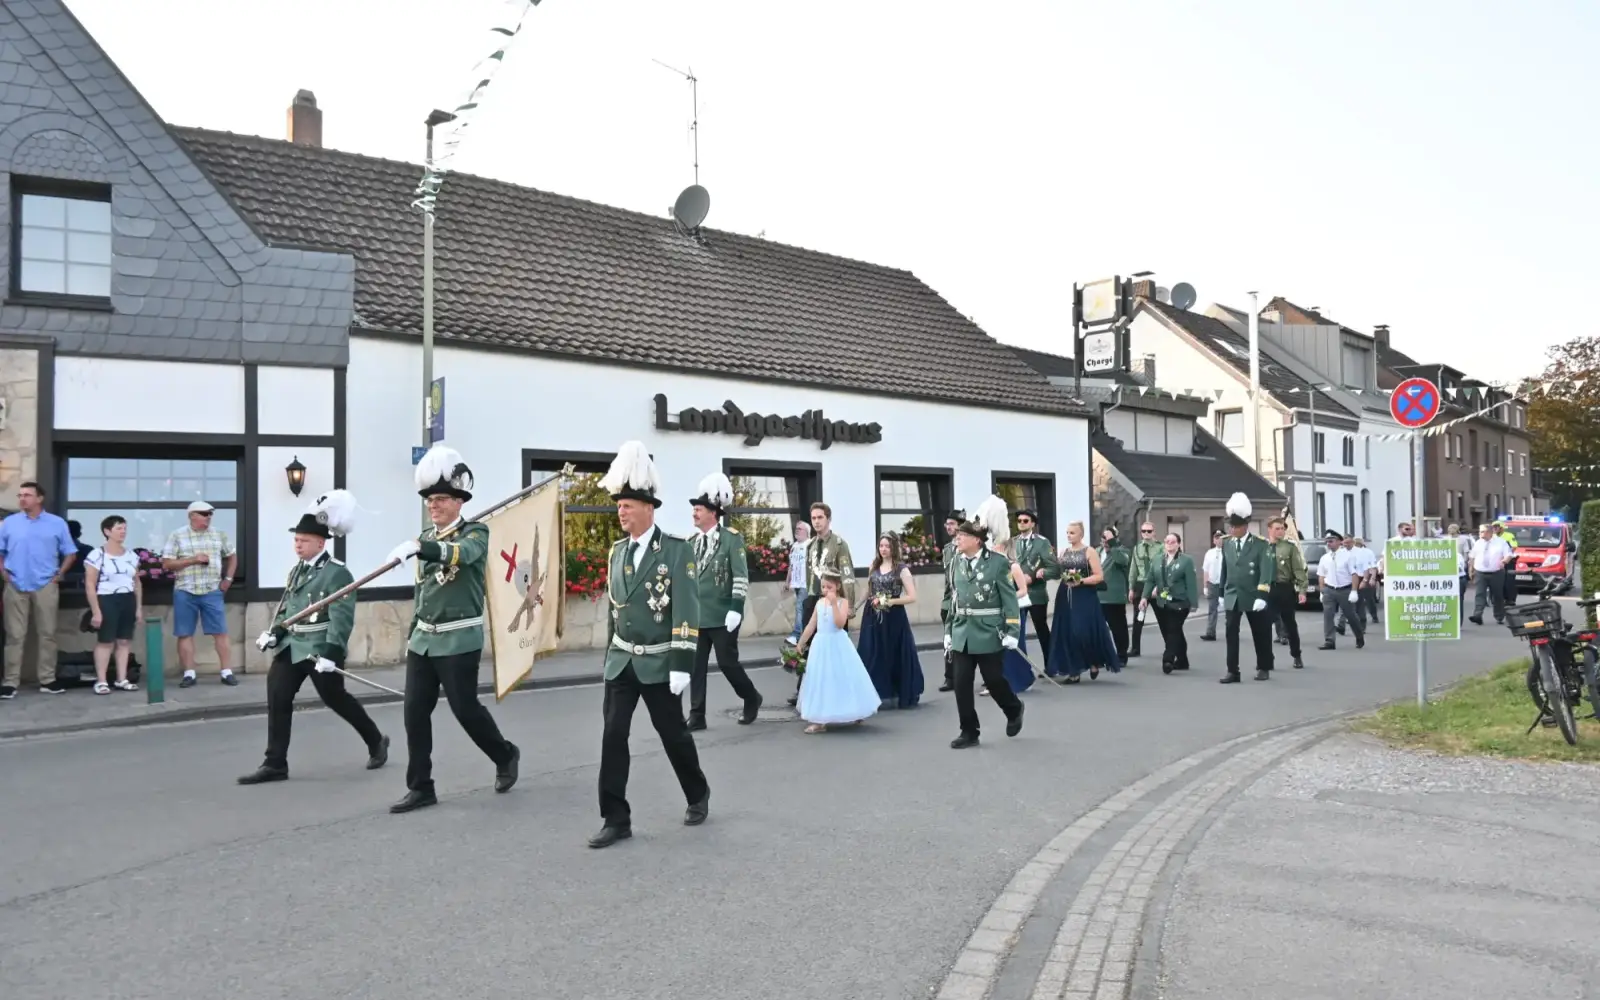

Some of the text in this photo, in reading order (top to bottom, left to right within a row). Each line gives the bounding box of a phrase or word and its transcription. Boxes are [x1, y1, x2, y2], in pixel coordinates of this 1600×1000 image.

[653, 393, 882, 450] Landgasthaus
[1390, 548, 1452, 560] Schützenfest
[1392, 580, 1421, 591] 30.08
[1429, 579, 1453, 590] 01.09
[1403, 601, 1447, 614] Festplatz
